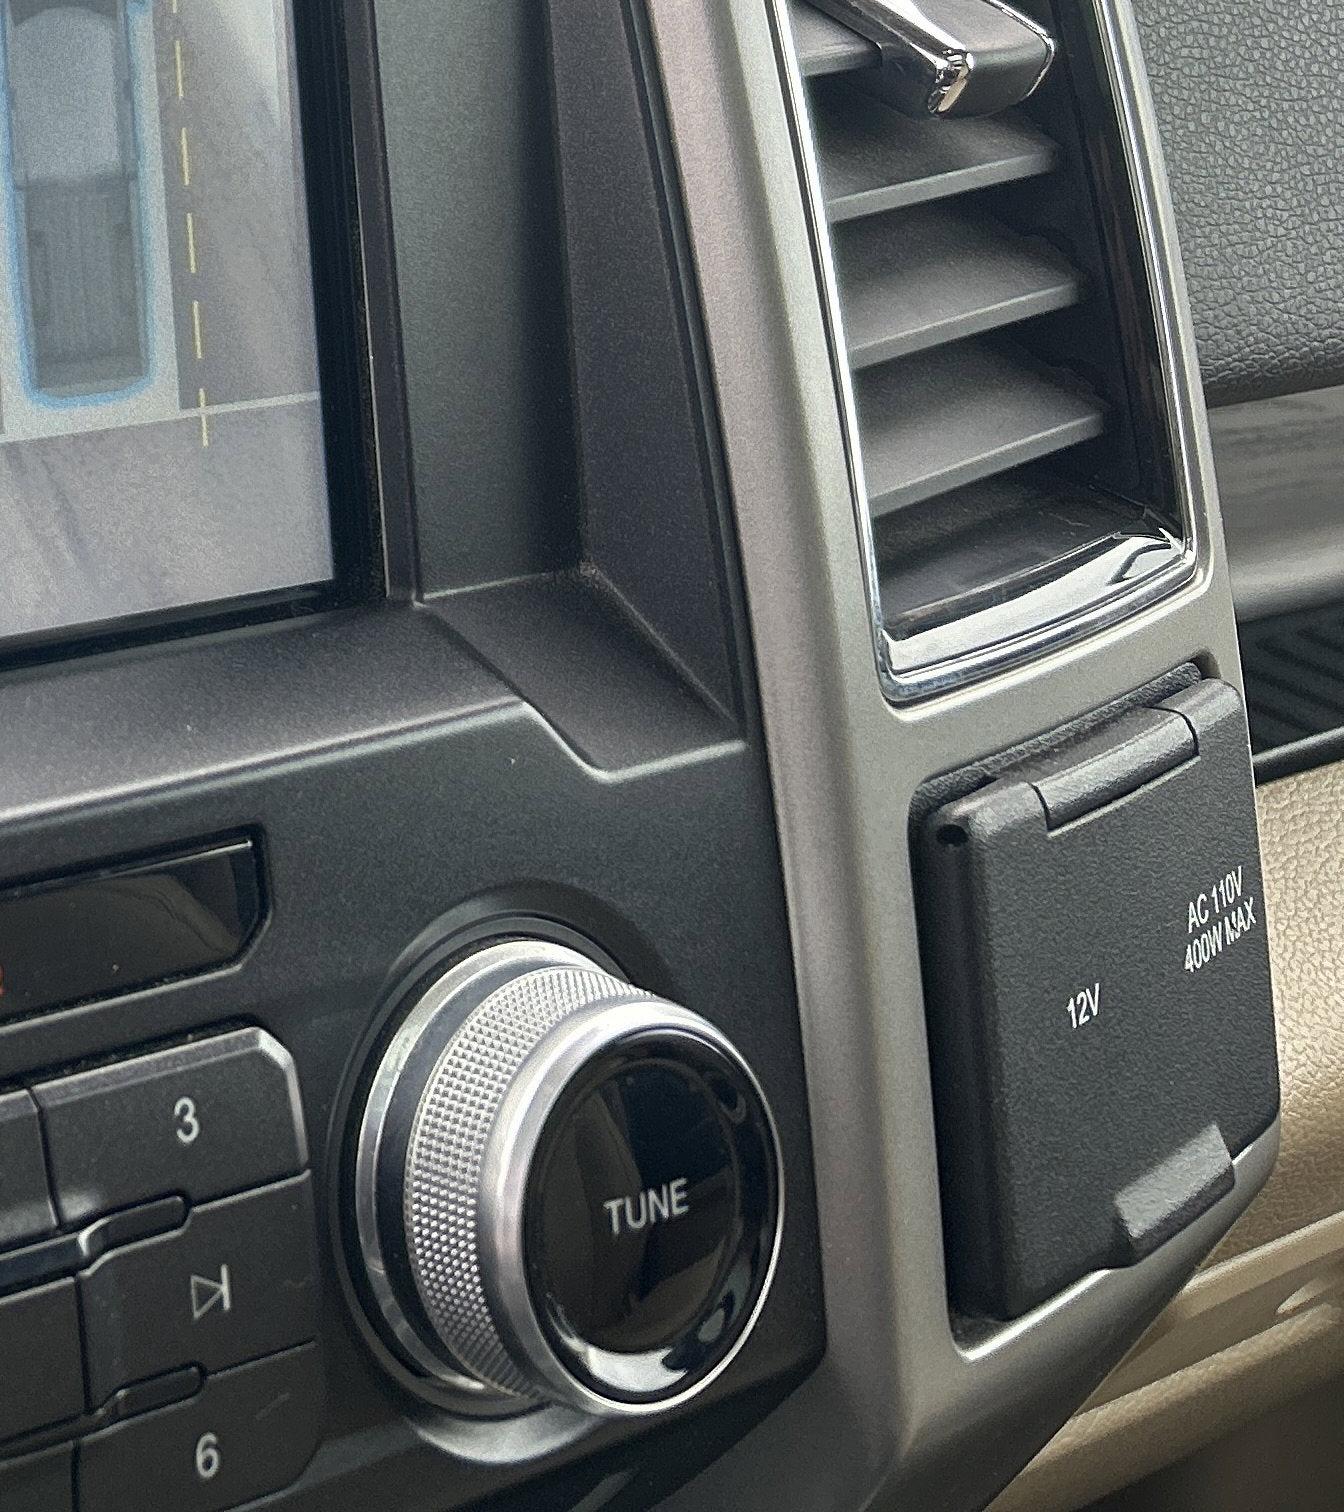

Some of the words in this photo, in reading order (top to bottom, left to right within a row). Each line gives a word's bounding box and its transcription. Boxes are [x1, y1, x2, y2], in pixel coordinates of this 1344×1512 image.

[1188, 893, 1210, 934] AC
[1211, 865, 1243, 914] 110V
[1184, 921, 1223, 973] 400W
[1224, 896, 1257, 946] MAX
[1066, 983, 1102, 1029] 12V
[172, 1096, 202, 1146] 3
[602, 1176, 691, 1236] TUNE
[194, 1431, 221, 1480] 6
